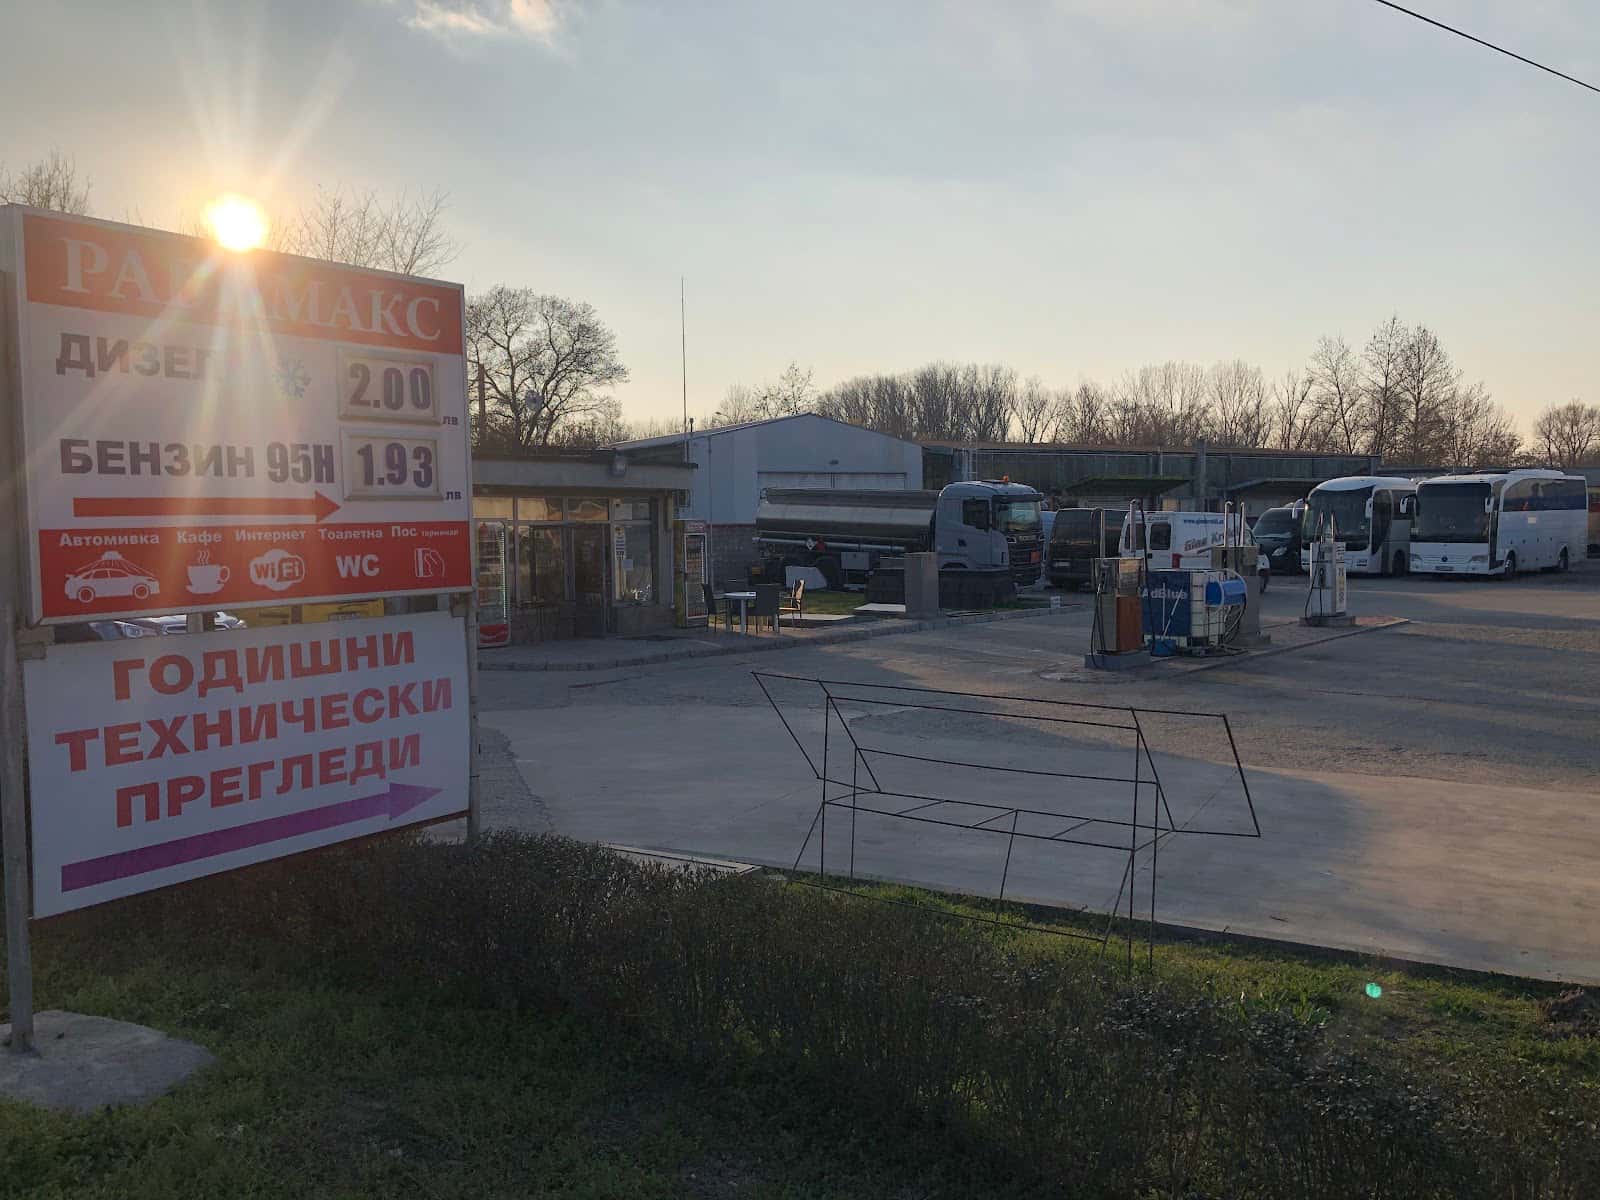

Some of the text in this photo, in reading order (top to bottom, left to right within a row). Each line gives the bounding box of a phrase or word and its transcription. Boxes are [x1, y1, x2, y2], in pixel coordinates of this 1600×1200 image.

[349, 363, 433, 411] 2.00
[60, 439, 255, 478] БЕНЗИН
[357, 442, 433, 488] 1.93
[59, 532, 160, 547] Автомивка
[176, 530, 222, 545] Кафе
[235, 528, 306, 543] Интернет
[319, 527, 383, 541] Тоалетна
[391, 525, 417, 538] Пос
[336, 554, 380, 578] WC
[112, 631, 415, 700] ГОДИШНИ
[55, 677, 453, 773] ТЕХНИЧЕСКИ
[116, 734, 421, 829] ПРЕГЛЕДИ
